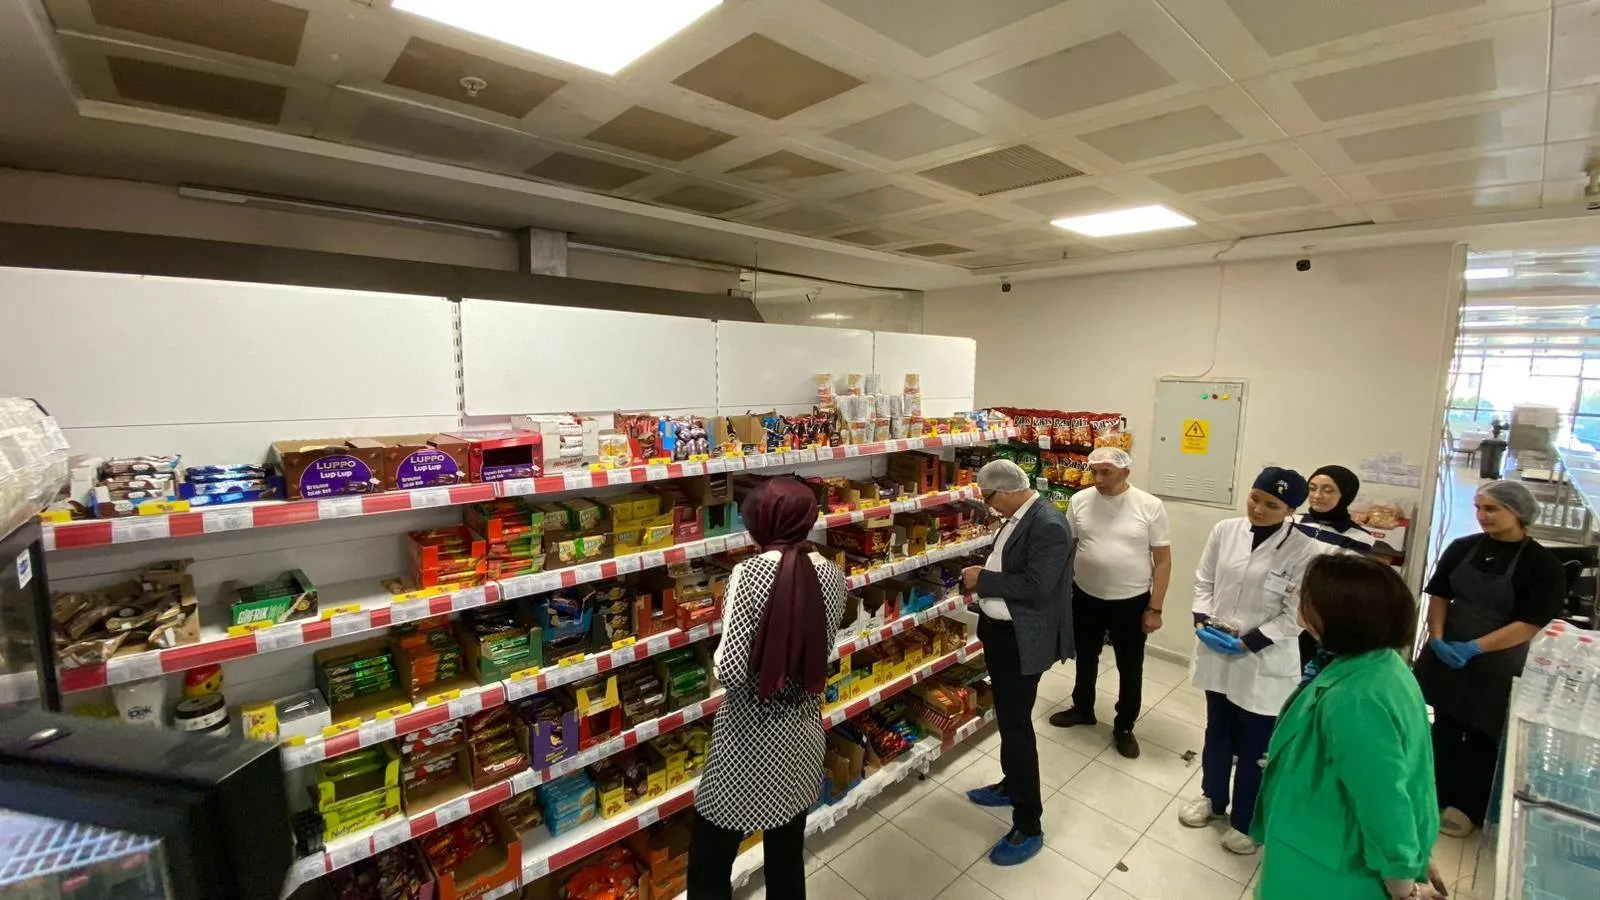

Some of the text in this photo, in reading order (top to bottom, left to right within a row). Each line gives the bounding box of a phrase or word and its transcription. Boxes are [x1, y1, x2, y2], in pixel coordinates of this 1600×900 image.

[410, 454, 445, 464] LUPPO
[316, 460, 357, 470] LUPPO
[413, 463, 442, 472] Lup Lup
[320, 470, 352, 479] Lup Lup
